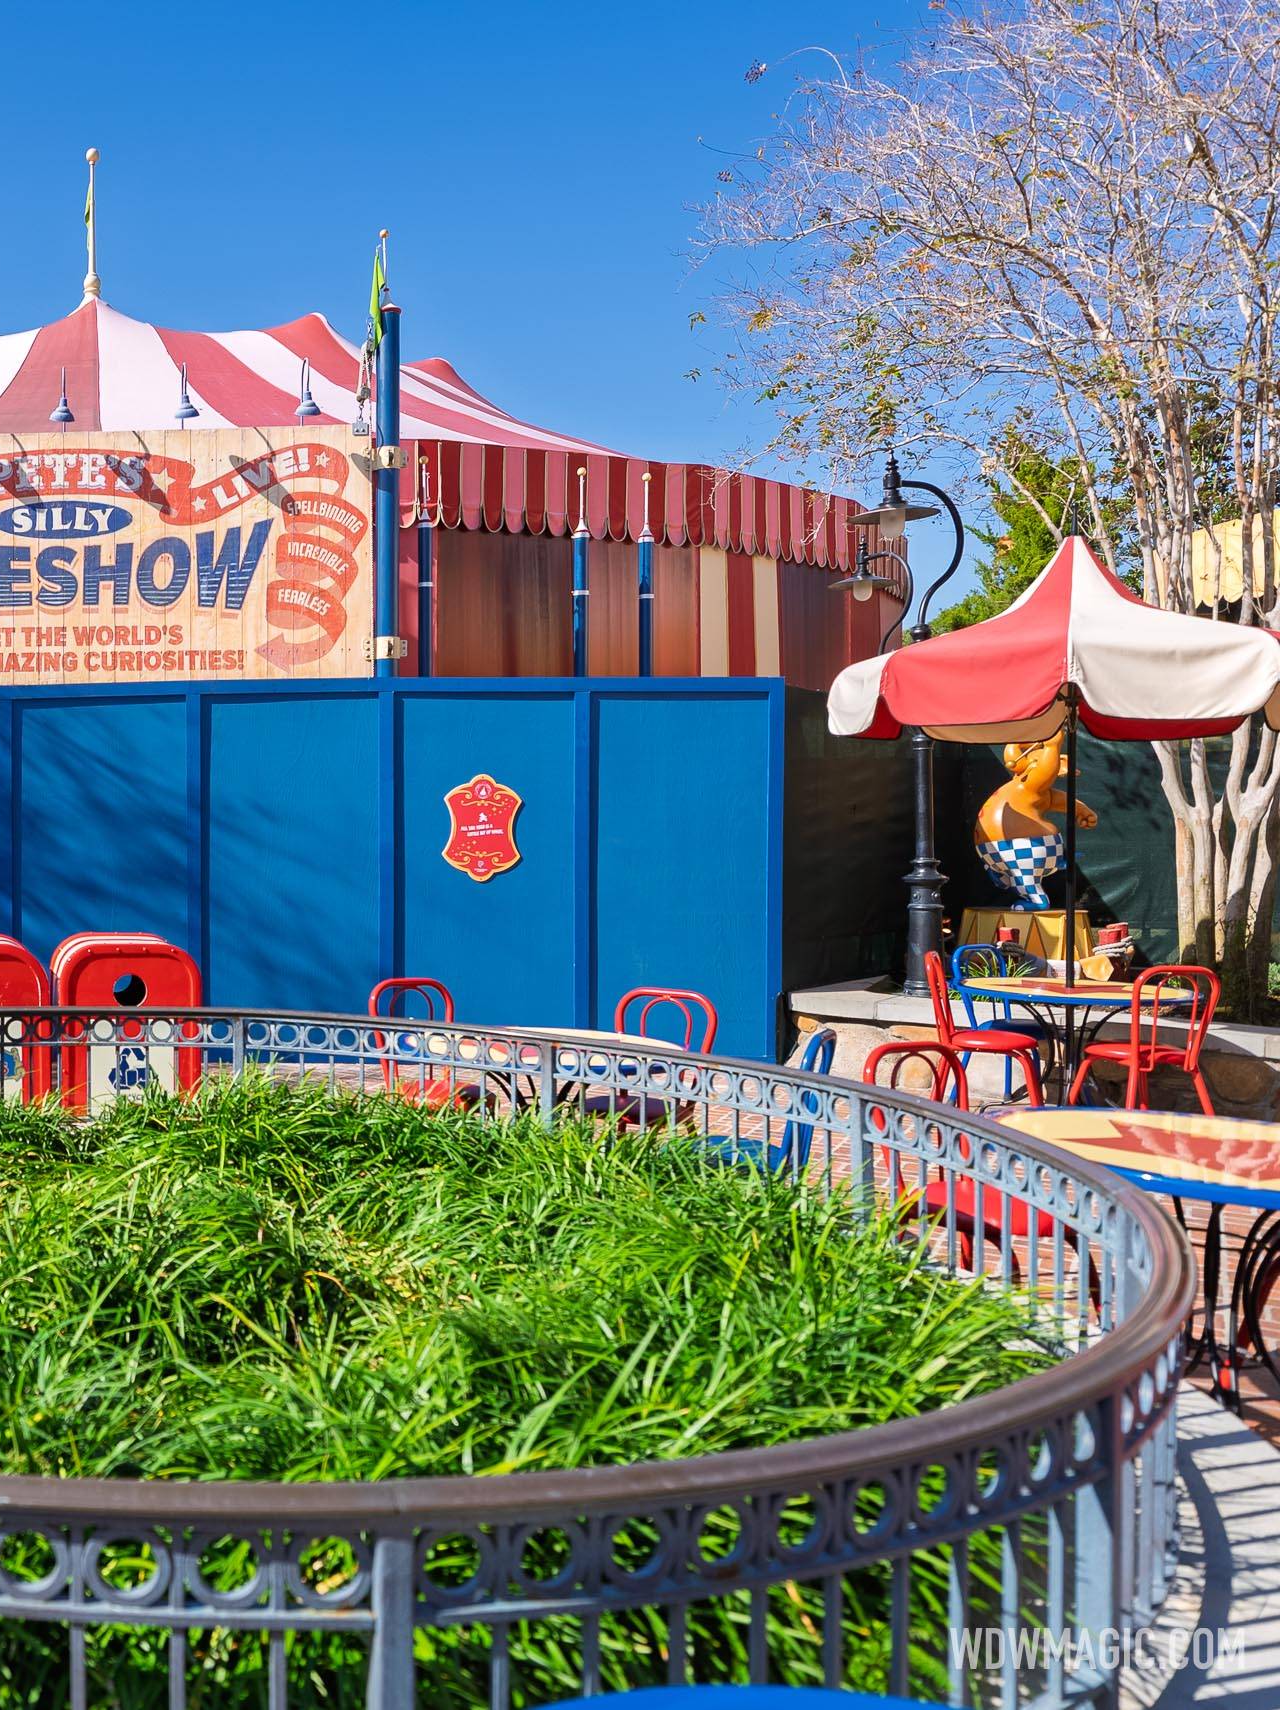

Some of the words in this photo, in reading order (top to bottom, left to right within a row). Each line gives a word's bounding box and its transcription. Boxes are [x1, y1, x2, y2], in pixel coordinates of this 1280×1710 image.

[211, 448, 311, 509] LIVE!
[11, 506, 115, 533] SILLY
[287, 500, 363, 534] SPELLBINDING
[288, 541, 349, 576] INCREDIBLE
[278, 588, 331, 616] FEARLESS
[21, 626, 66, 647] THE
[73, 625, 184, 646] WORLD'S
[84, 649, 245, 672] CURIOSITIES!
